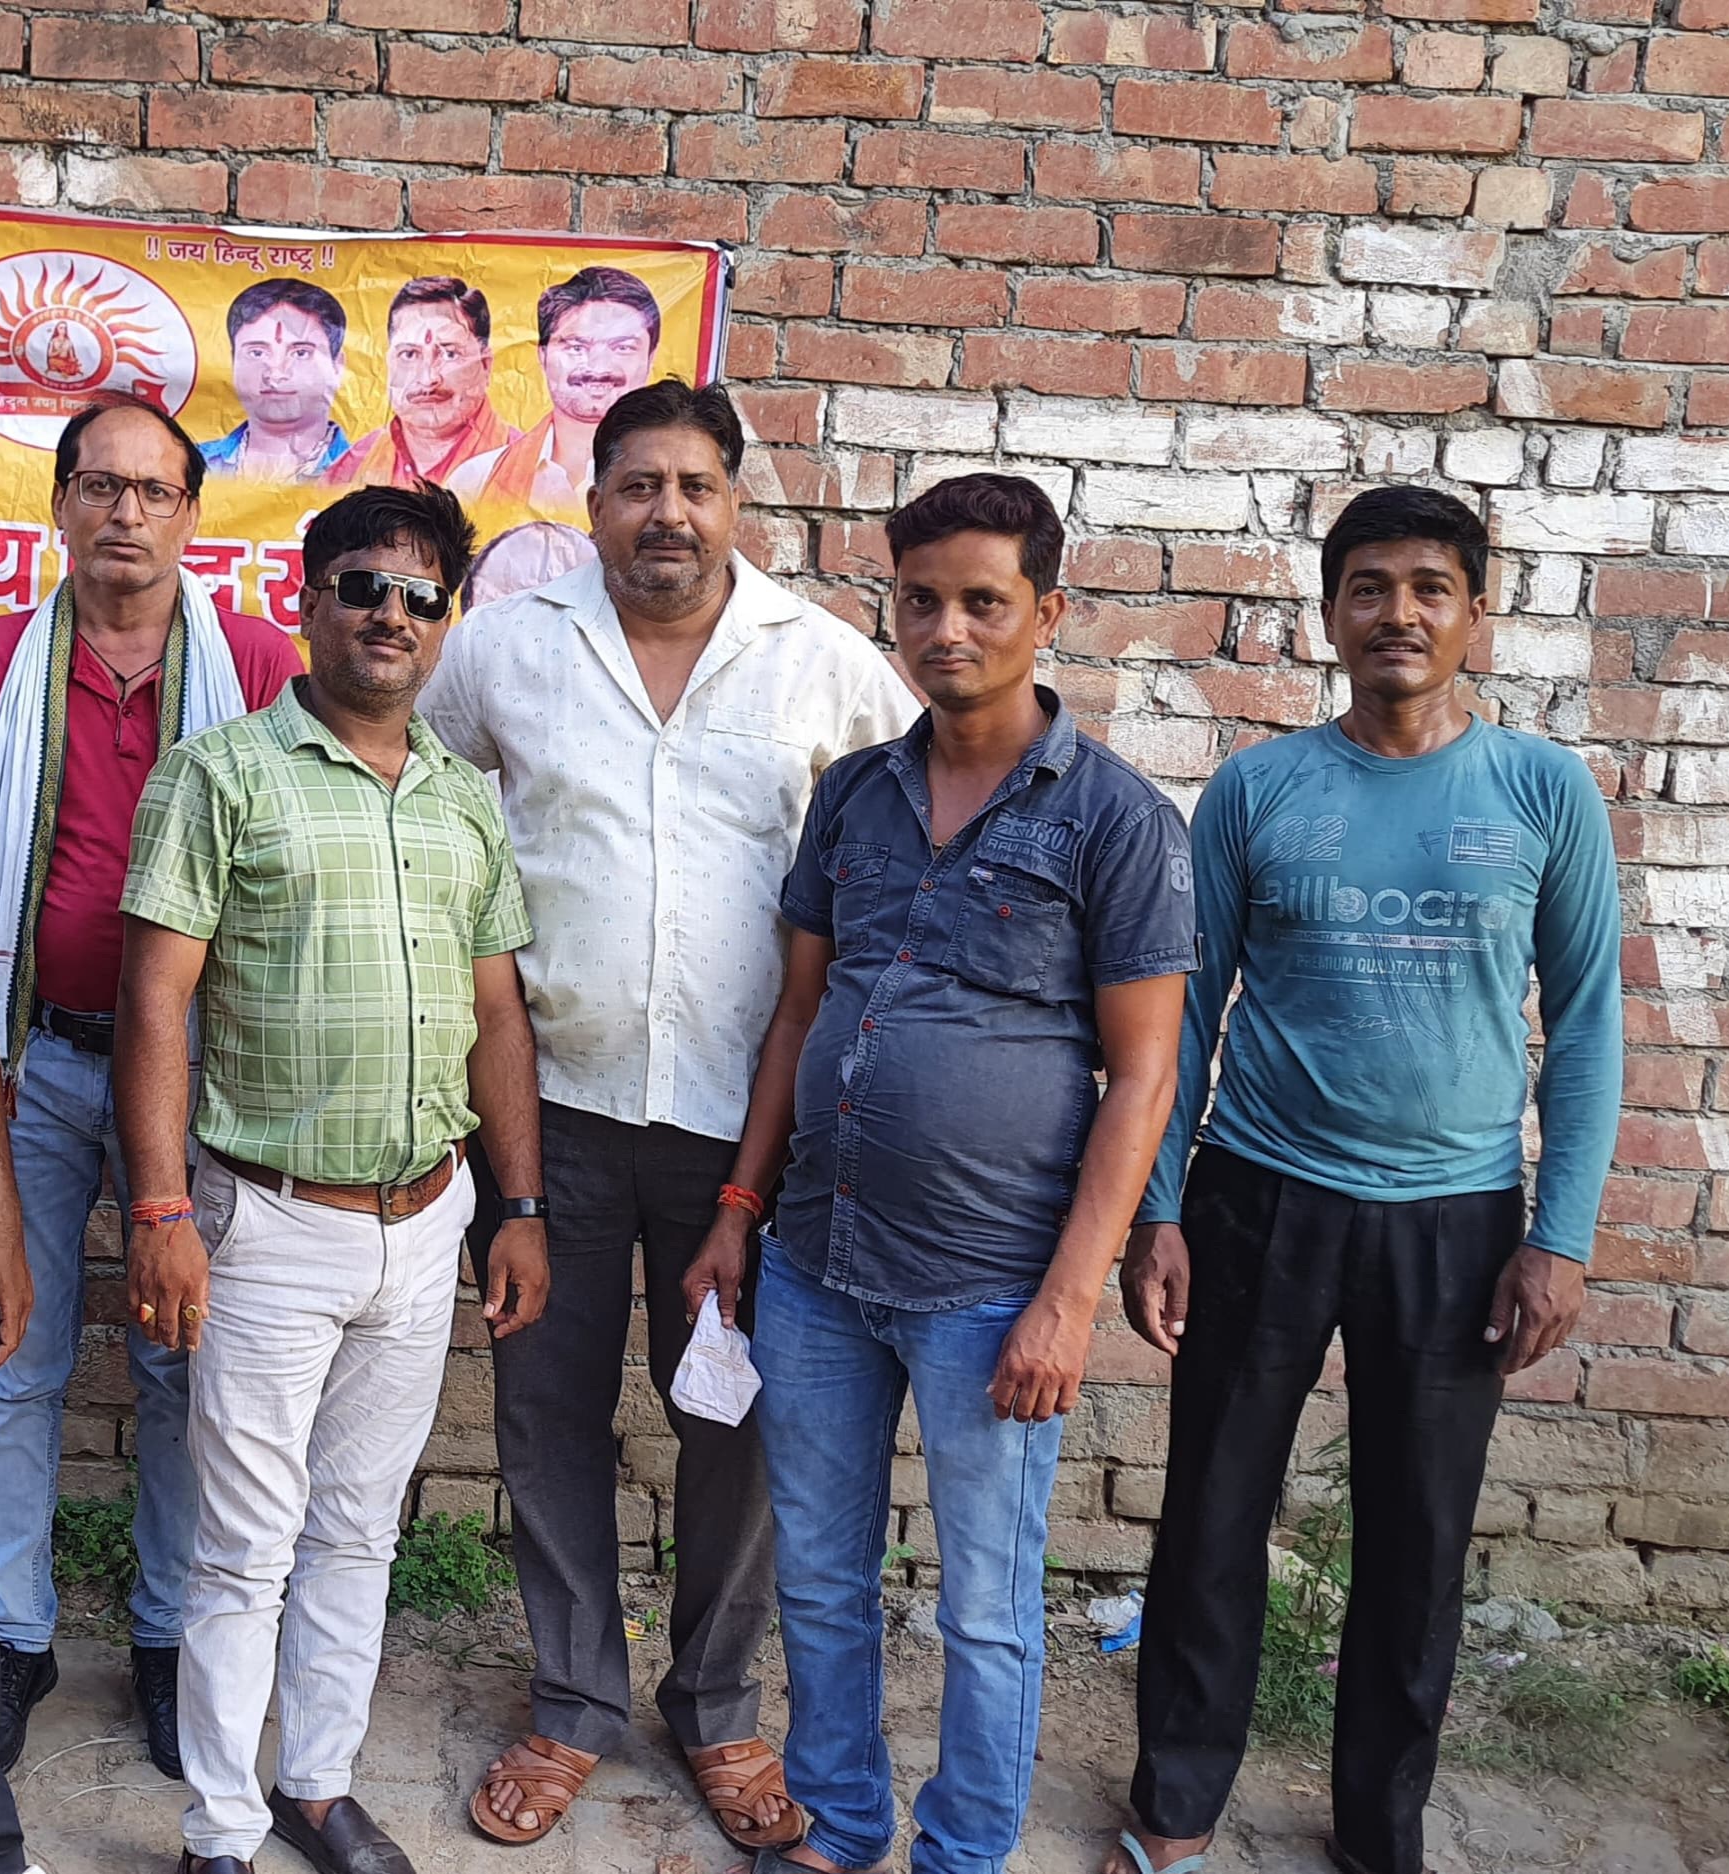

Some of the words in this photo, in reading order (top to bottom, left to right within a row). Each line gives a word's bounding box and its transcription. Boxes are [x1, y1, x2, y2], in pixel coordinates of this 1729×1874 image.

[167, 241, 207, 260] जय
[214, 237, 265, 271] हिन्दू
[268, 246, 313, 271] राष्ट्र
[1271, 815, 1349, 863] 82
[1296, 953, 1353, 972] PREMIUM
